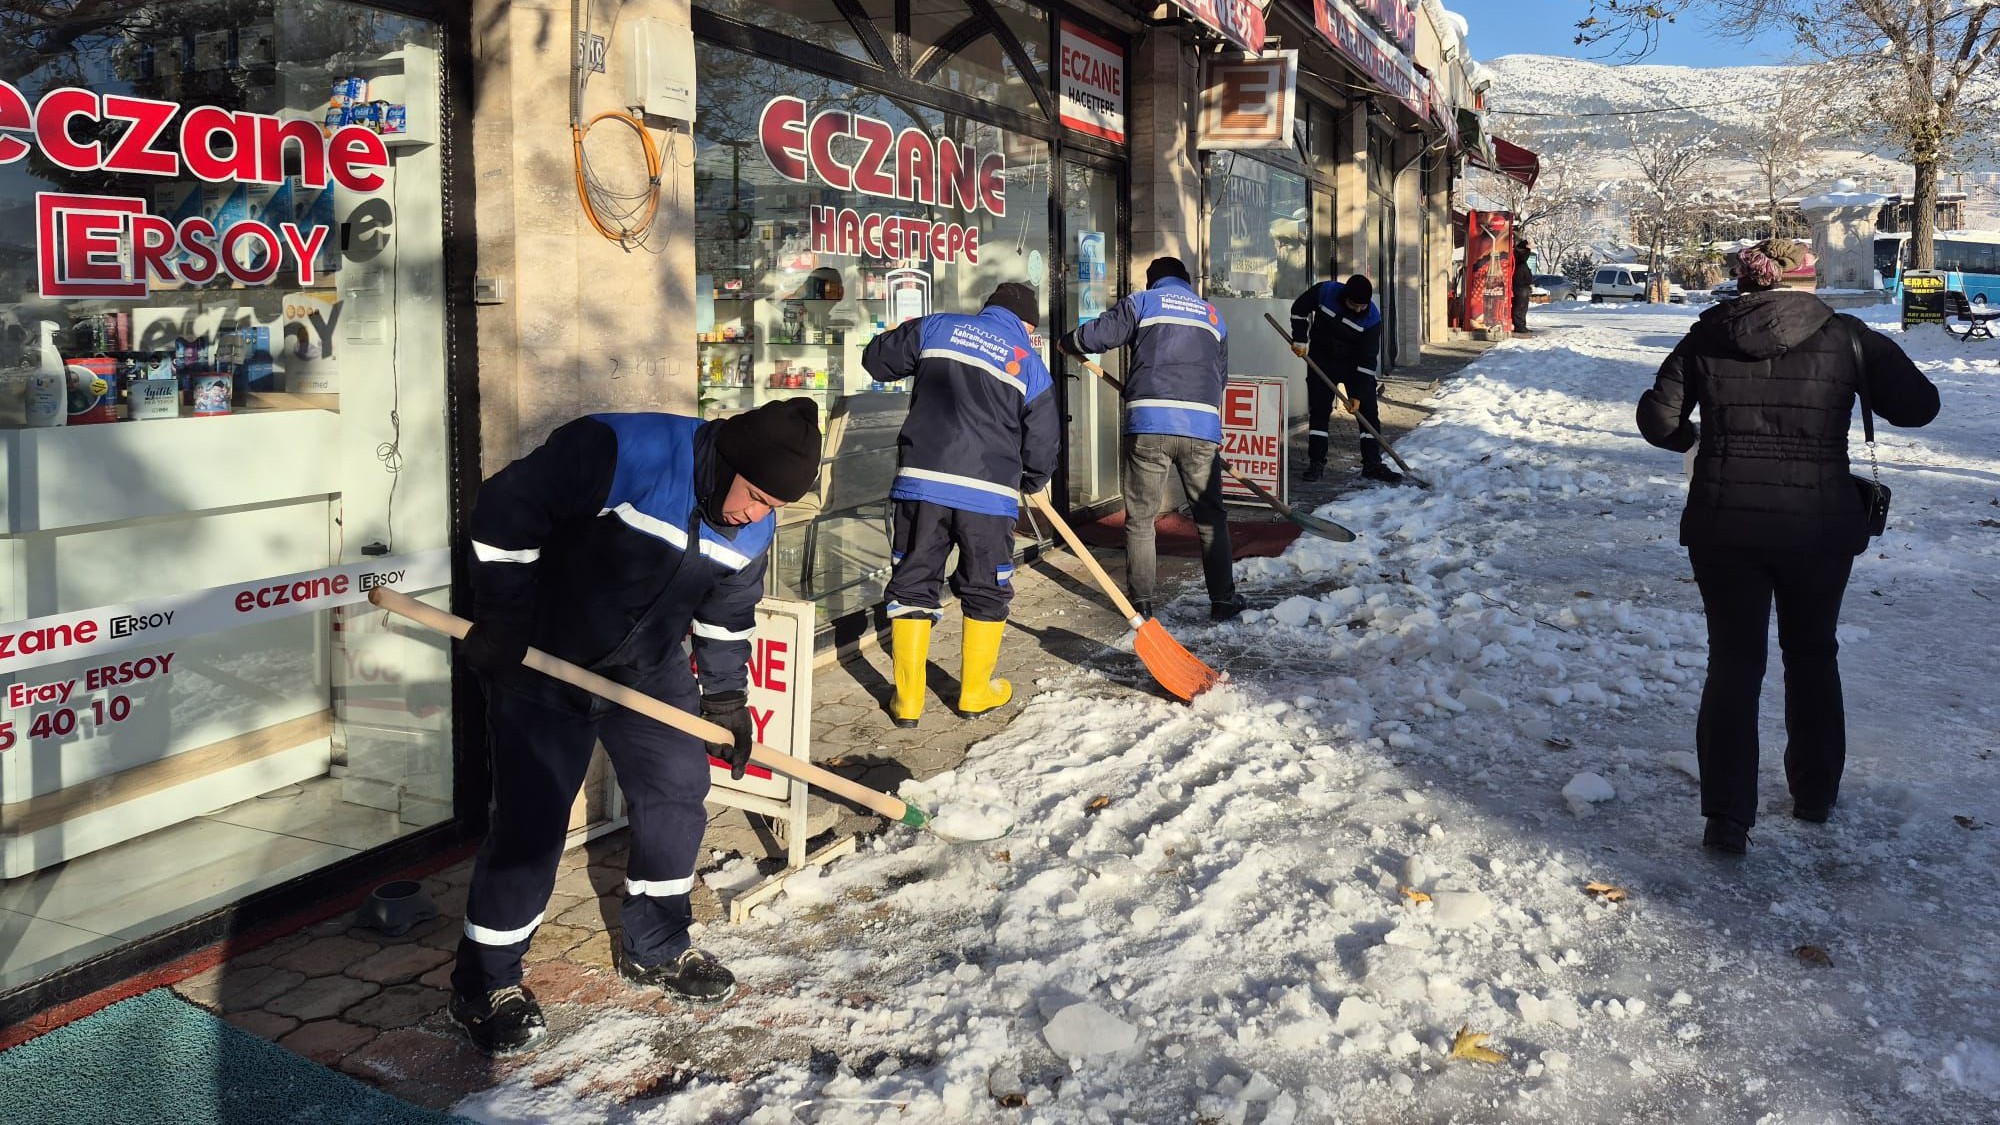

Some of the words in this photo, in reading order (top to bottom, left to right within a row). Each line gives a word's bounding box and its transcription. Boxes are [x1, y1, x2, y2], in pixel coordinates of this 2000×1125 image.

[1326, 6, 1374, 69] HARUN
[1061, 45, 1120, 97] ECZANE
[1068, 86, 1115, 117] HACETTEPE
[1220, 71, 1269, 128] E
[759, 95, 1006, 217] ECZANE
[1231, 177, 1265, 208] HARUN
[52, 203, 328, 289] ERSOY
[810, 204, 979, 265] HACETTEPE
[953, 328, 1008, 357] Kahramanmaraş
[1225, 388, 1253, 427] E
[234, 573, 349, 612] eczane
[358, 570, 405, 593] ERSOY
[110, 611, 175, 640] ERSOY
[9, 679, 77, 709] Eray
[86, 652, 175, 691] ERSOY
[29, 708, 77, 739] 40
[91, 695, 131, 726] 10
